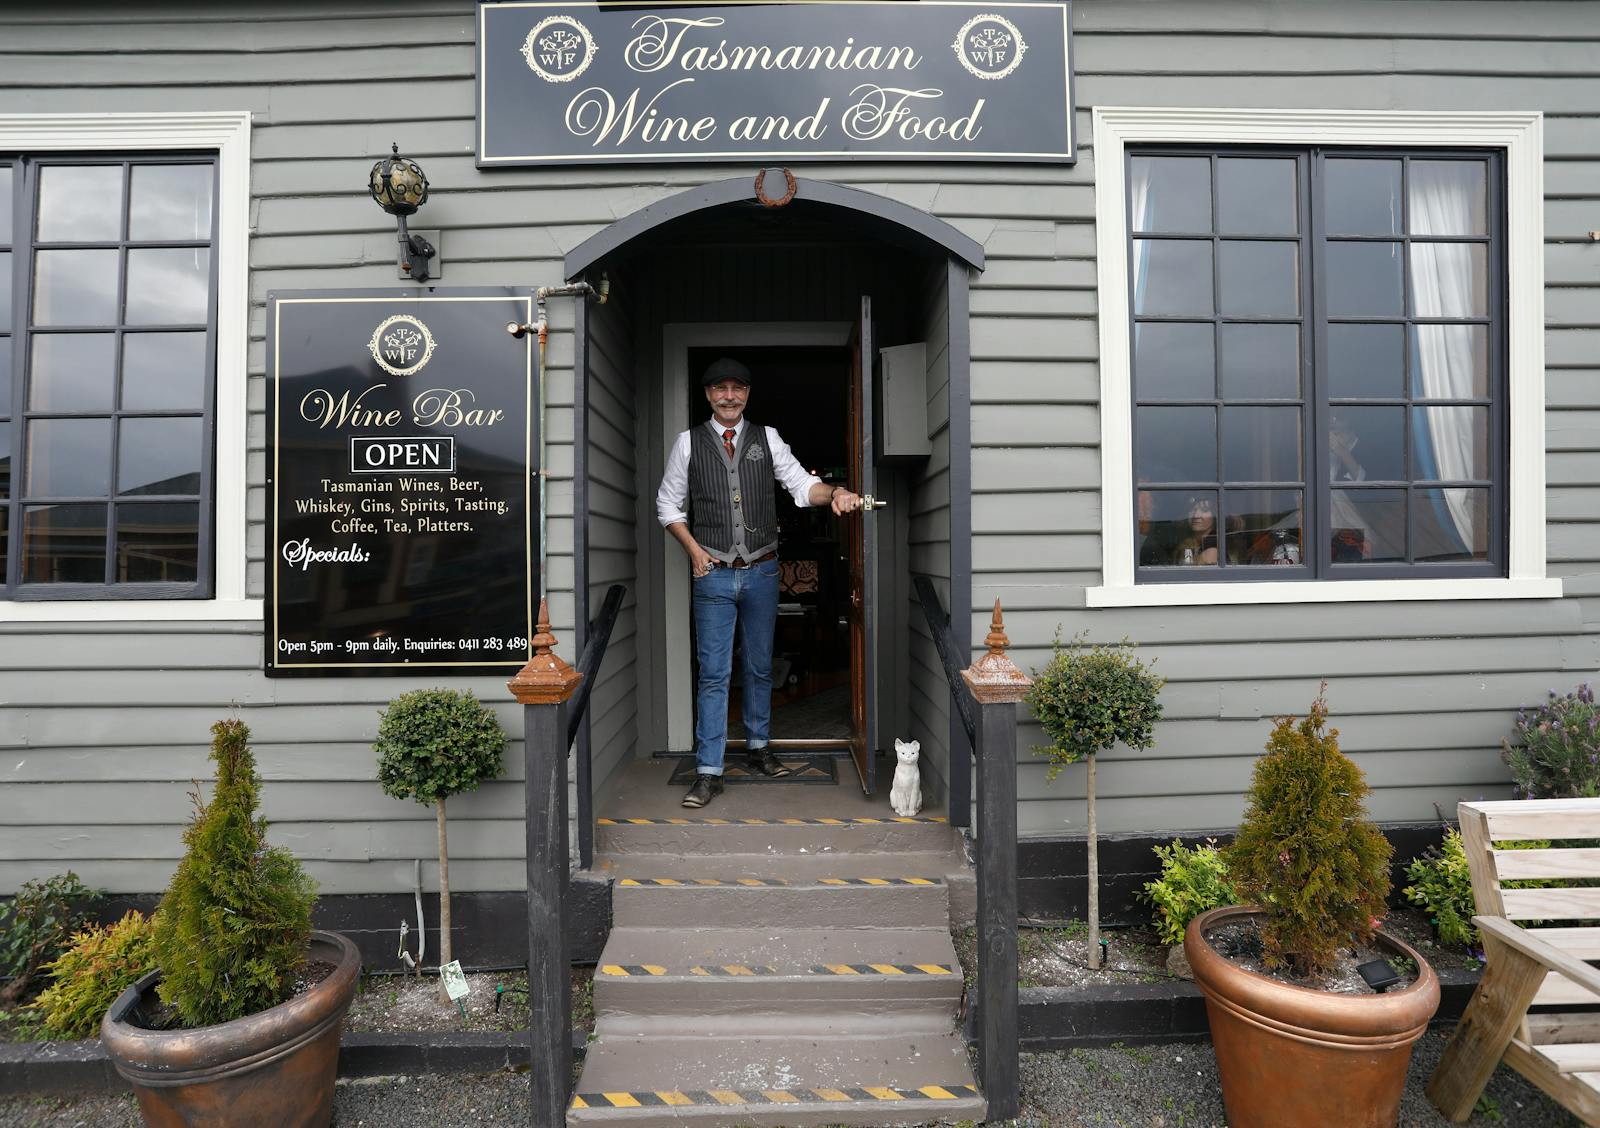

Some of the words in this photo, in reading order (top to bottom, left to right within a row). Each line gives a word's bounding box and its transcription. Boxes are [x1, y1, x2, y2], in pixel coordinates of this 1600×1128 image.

[623, 15, 923, 74] Tasmanian
[564, 77, 717, 147] Wine
[729, 97, 831, 141] and
[840, 83, 985, 142] Food
[300, 383, 403, 430] Wine
[412, 388, 505, 427] Bar
[364, 442, 440, 467] OPEN
[320, 478, 393, 493] Tasmanian
[399, 477, 444, 493] Wines,
[449, 477, 483, 492] Beer,
[295, 498, 355, 516] Whiskey,
[360, 498, 395, 514] Gins,
[400, 497, 449, 515] Spirits,
[454, 497, 509, 515] Tasting,
[331, 518, 378, 534] Coffee,
[383, 518, 412, 534] Tea,
[417, 517, 474, 532] Platters.
[282, 537, 371, 571] Specials:
[278, 639, 307, 654] Open
[310, 639, 334, 654] 5pm
[345, 639, 369, 654] 9pm
[372, 638, 400, 654] daily.
[404, 638, 455, 653] Enquiries:
[458, 638, 480, 650] 0411
[483, 638, 503, 651] 283
[506, 636, 528, 650] 489
